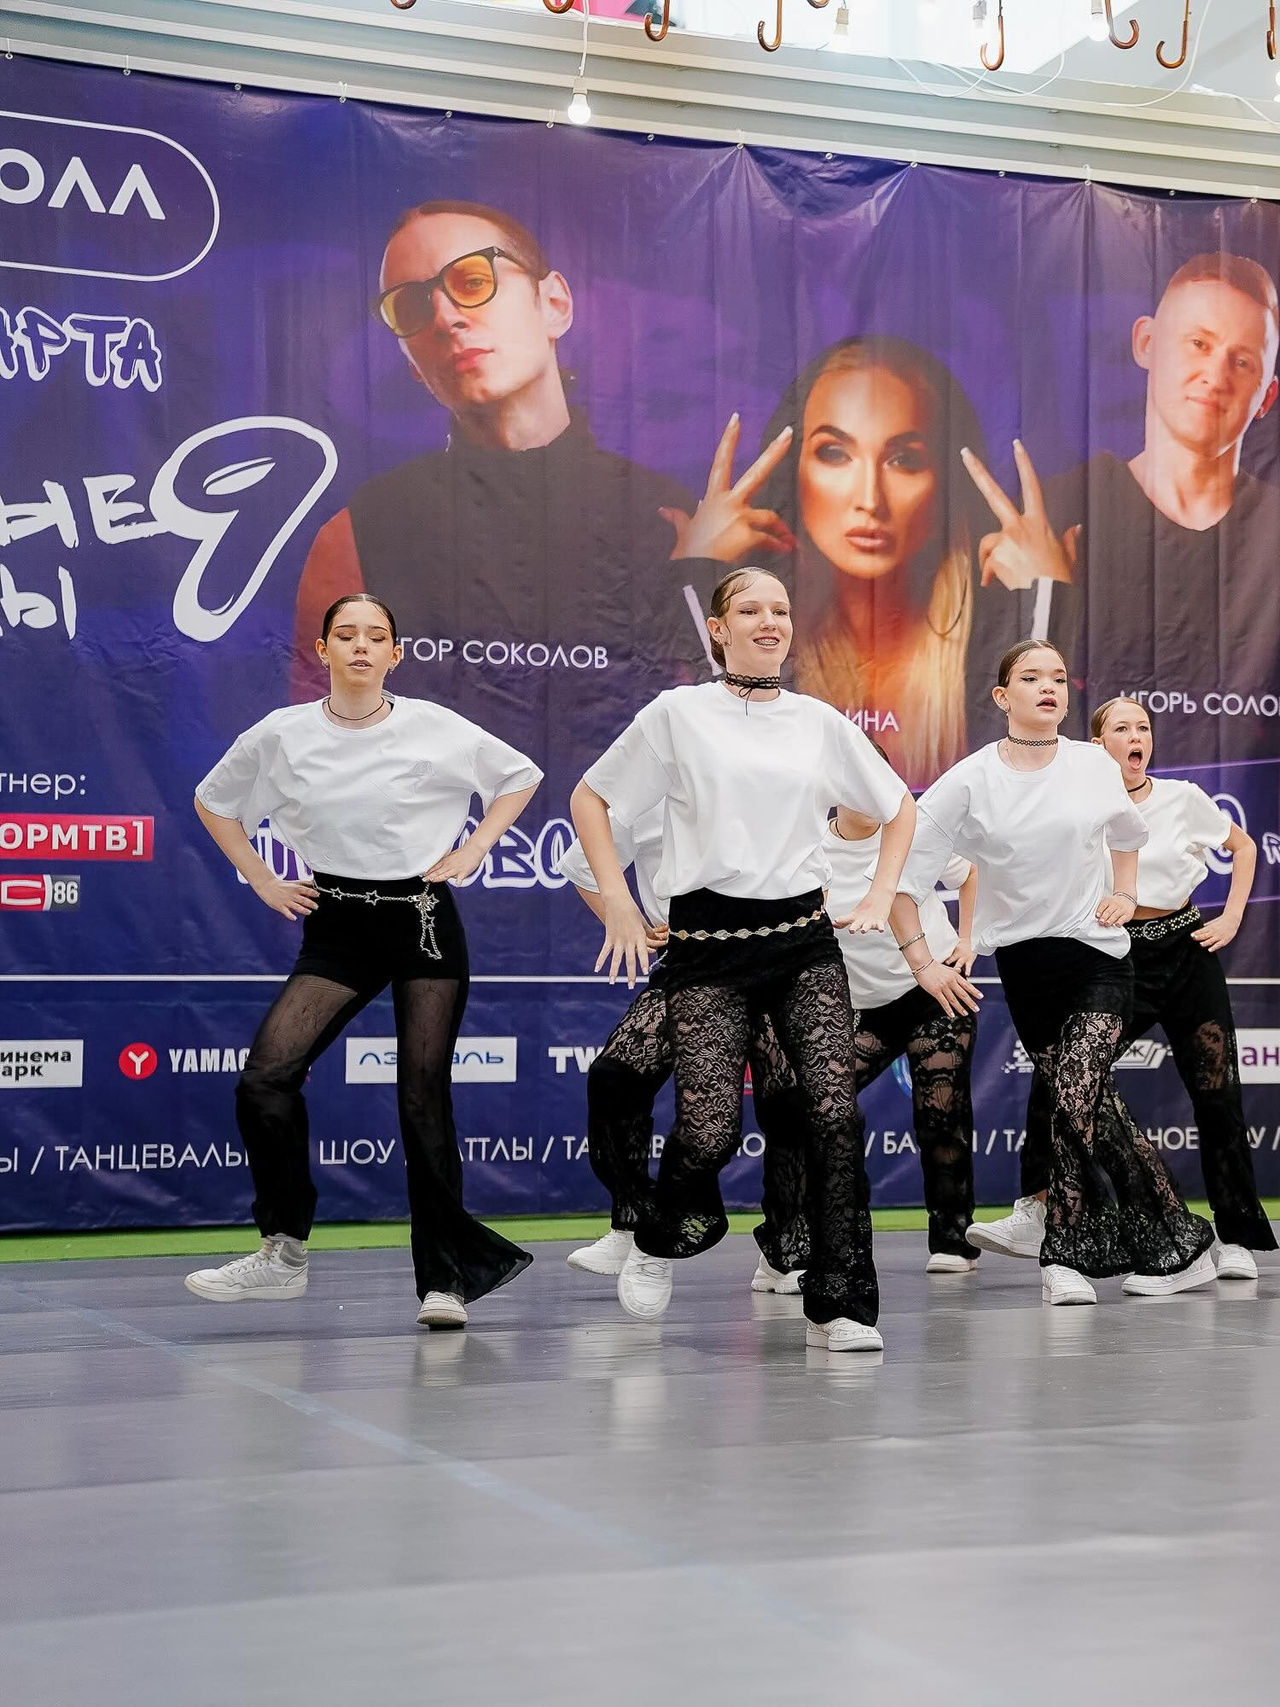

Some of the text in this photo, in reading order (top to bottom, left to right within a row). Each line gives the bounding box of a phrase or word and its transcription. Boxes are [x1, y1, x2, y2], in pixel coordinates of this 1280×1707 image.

[396, 637, 609, 669] ГОР СОКОЛОВ
[54, 1142, 249, 1172] ТАНЦЕВАЛЬ
[319, 1139, 395, 1165] ШОУ
